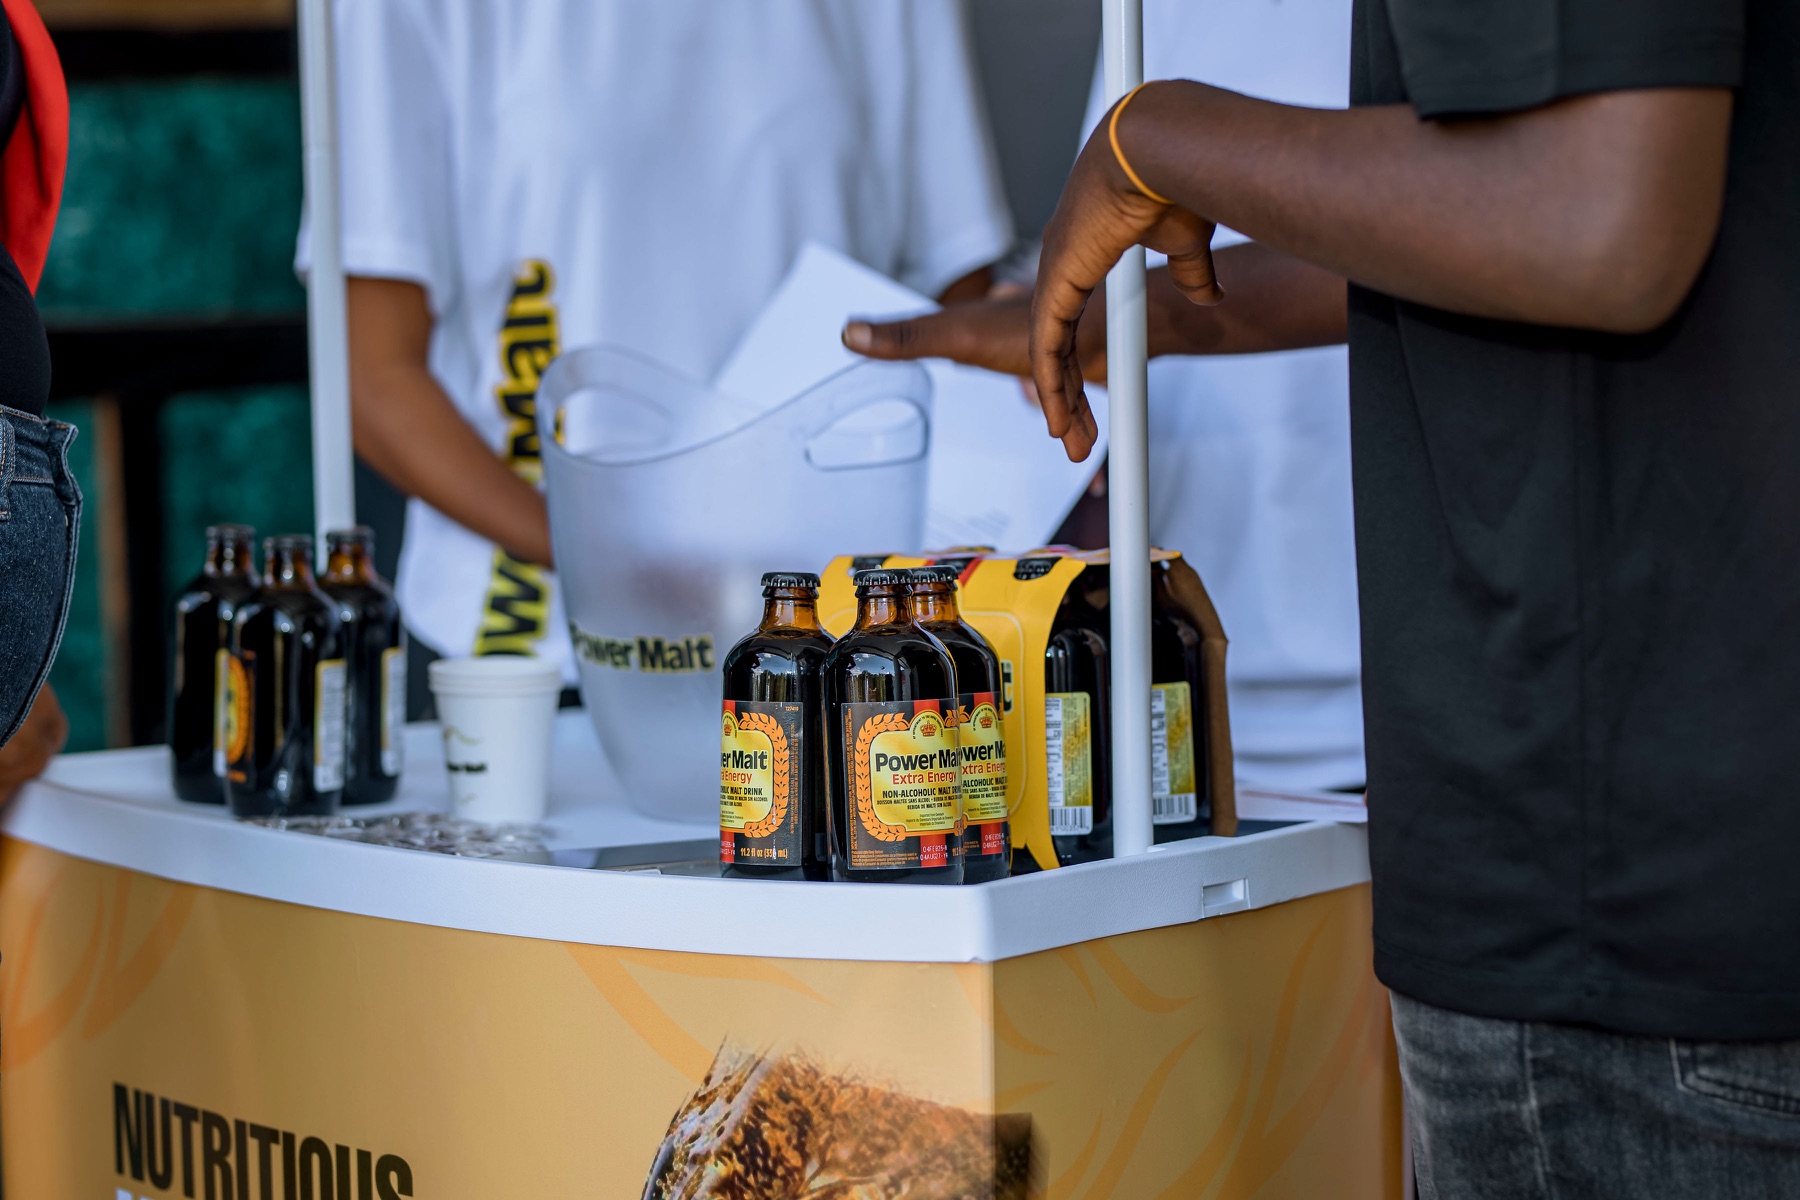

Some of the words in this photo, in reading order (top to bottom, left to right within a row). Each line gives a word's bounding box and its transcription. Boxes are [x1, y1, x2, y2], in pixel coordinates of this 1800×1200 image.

[635, 634, 715, 673] Malt
[732, 750, 768, 770] Malt
[875, 753, 937, 772] Power
[962, 763, 984, 775] xtra
[725, 771, 753, 784] Energy
[892, 773, 924, 785] Extra
[927, 771, 957, 783] Energy
[962, 778, 994, 788] -ALCOHOLIC
[730, 786, 743, 795] MALT
[743, 787, 763, 796] DRINK
[882, 787, 936, 798] NON-ALCOHOLIC
[937, 786, 951, 796] MALT
[740, 847, 751, 857] 11.2
[751, 847, 756, 857] fl
[756, 849, 763, 857] oz
[764, 848, 777, 859] (33
[112, 1081, 413, 1200] NUTRITIOUS
